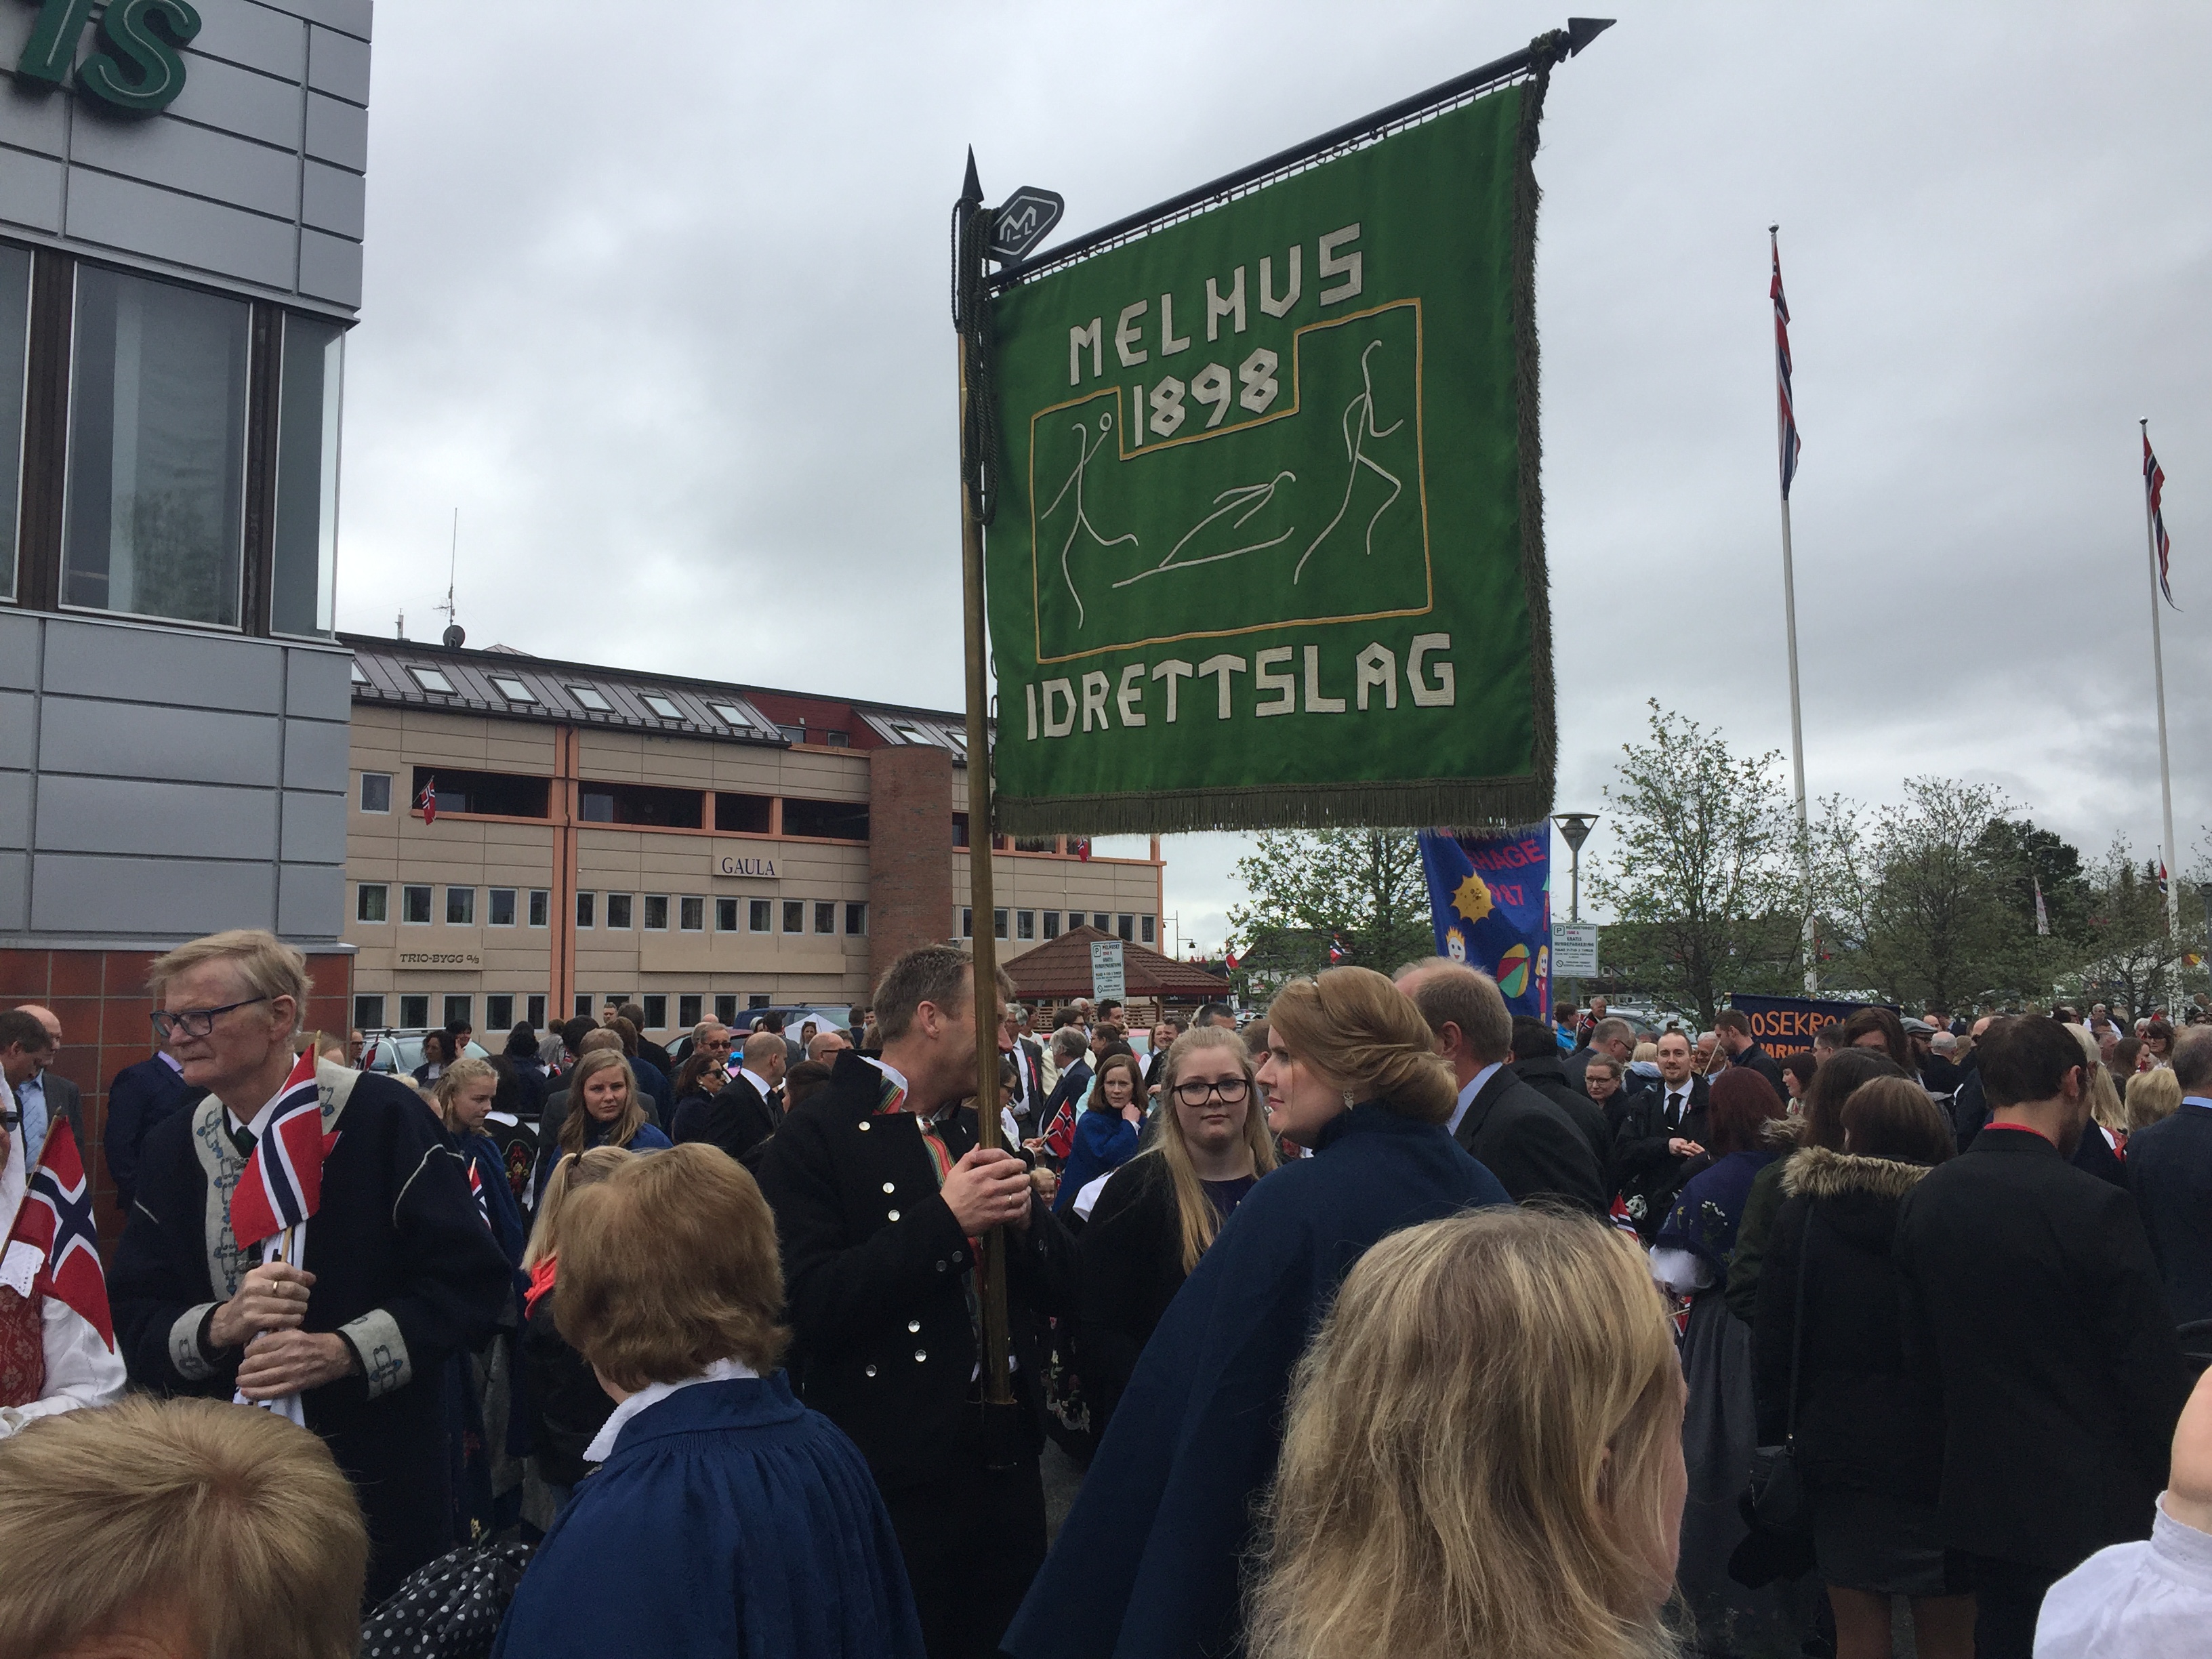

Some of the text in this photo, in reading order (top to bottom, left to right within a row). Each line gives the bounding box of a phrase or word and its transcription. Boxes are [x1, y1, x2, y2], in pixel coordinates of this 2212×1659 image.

[1069, 222, 1362, 386] MELHUS
[1134, 348, 1278, 447] 1898
[1026, 632, 1455, 740] IDRETTSLAG
[722, 857, 775, 876] GAULA
[400, 954, 464, 963] TRIO-BYGG
